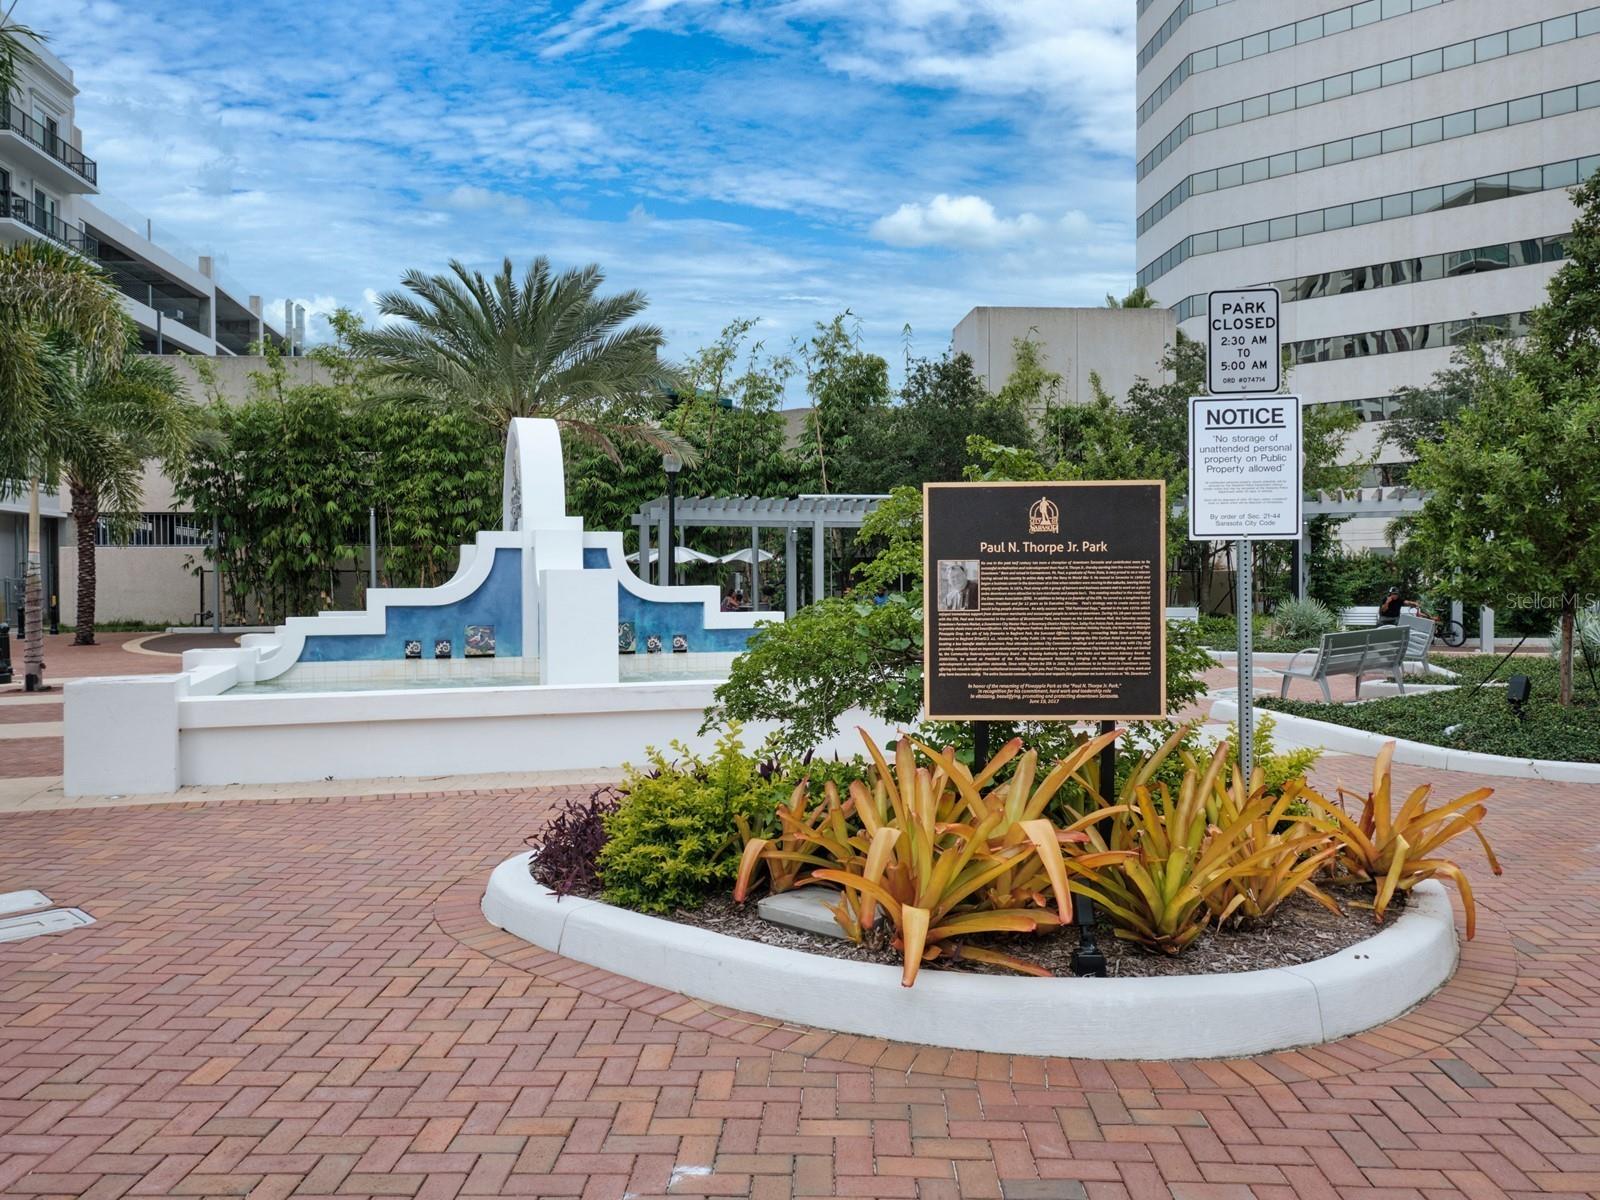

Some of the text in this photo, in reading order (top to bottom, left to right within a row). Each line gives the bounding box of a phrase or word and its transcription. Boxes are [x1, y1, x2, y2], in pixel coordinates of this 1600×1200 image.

[1222, 301, 1266, 315] PARK
[1212, 317, 1276, 331] CLOSED
[1221, 335, 1267, 346] 2:30 AM
[1237, 348, 1250, 358] TO
[1221, 360, 1268, 371] 5:00 AM
[1206, 407, 1284, 425] NOTICE
[1231, 435, 1266, 445] storage
[1269, 433, 1279, 442] of
[1199, 443, 1292, 455] unattended personal
[1204, 455, 1242, 465] property
[1260, 453, 1287, 462] Public
[1206, 464, 1245, 475] Property
[980, 540, 1108, 556] Paul N. Thorpe Jr. Park
